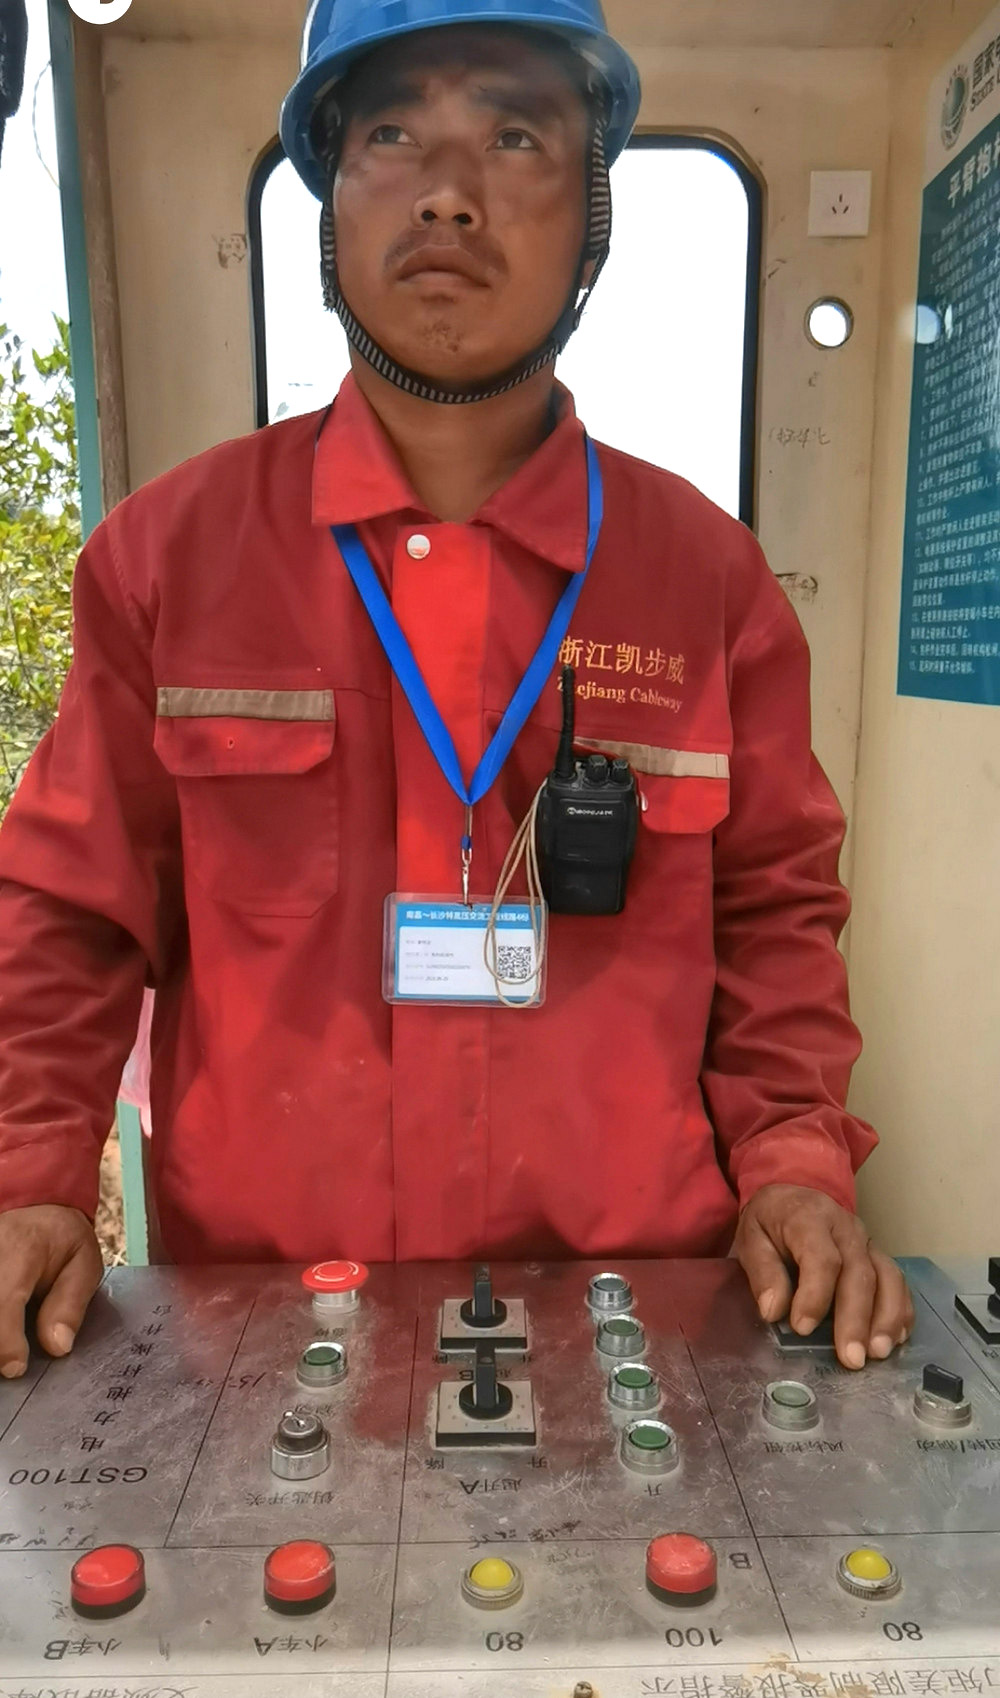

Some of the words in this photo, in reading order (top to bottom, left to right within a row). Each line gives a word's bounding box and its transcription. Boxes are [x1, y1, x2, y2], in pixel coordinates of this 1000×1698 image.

[558, 634, 685, 685] 浙江凯步威
[557, 676, 626, 703] ejiang
[630, 686, 682, 713] Cableway
[8, 1467, 148, 1486] GST100
[486, 1631, 525, 1652] 80
[664, 1626, 723, 1648] 100
[882, 1621, 924, 1642] 80
[43, 1637, 122, 1661] 小车B
[254, 1635, 328, 1657] 小车A
